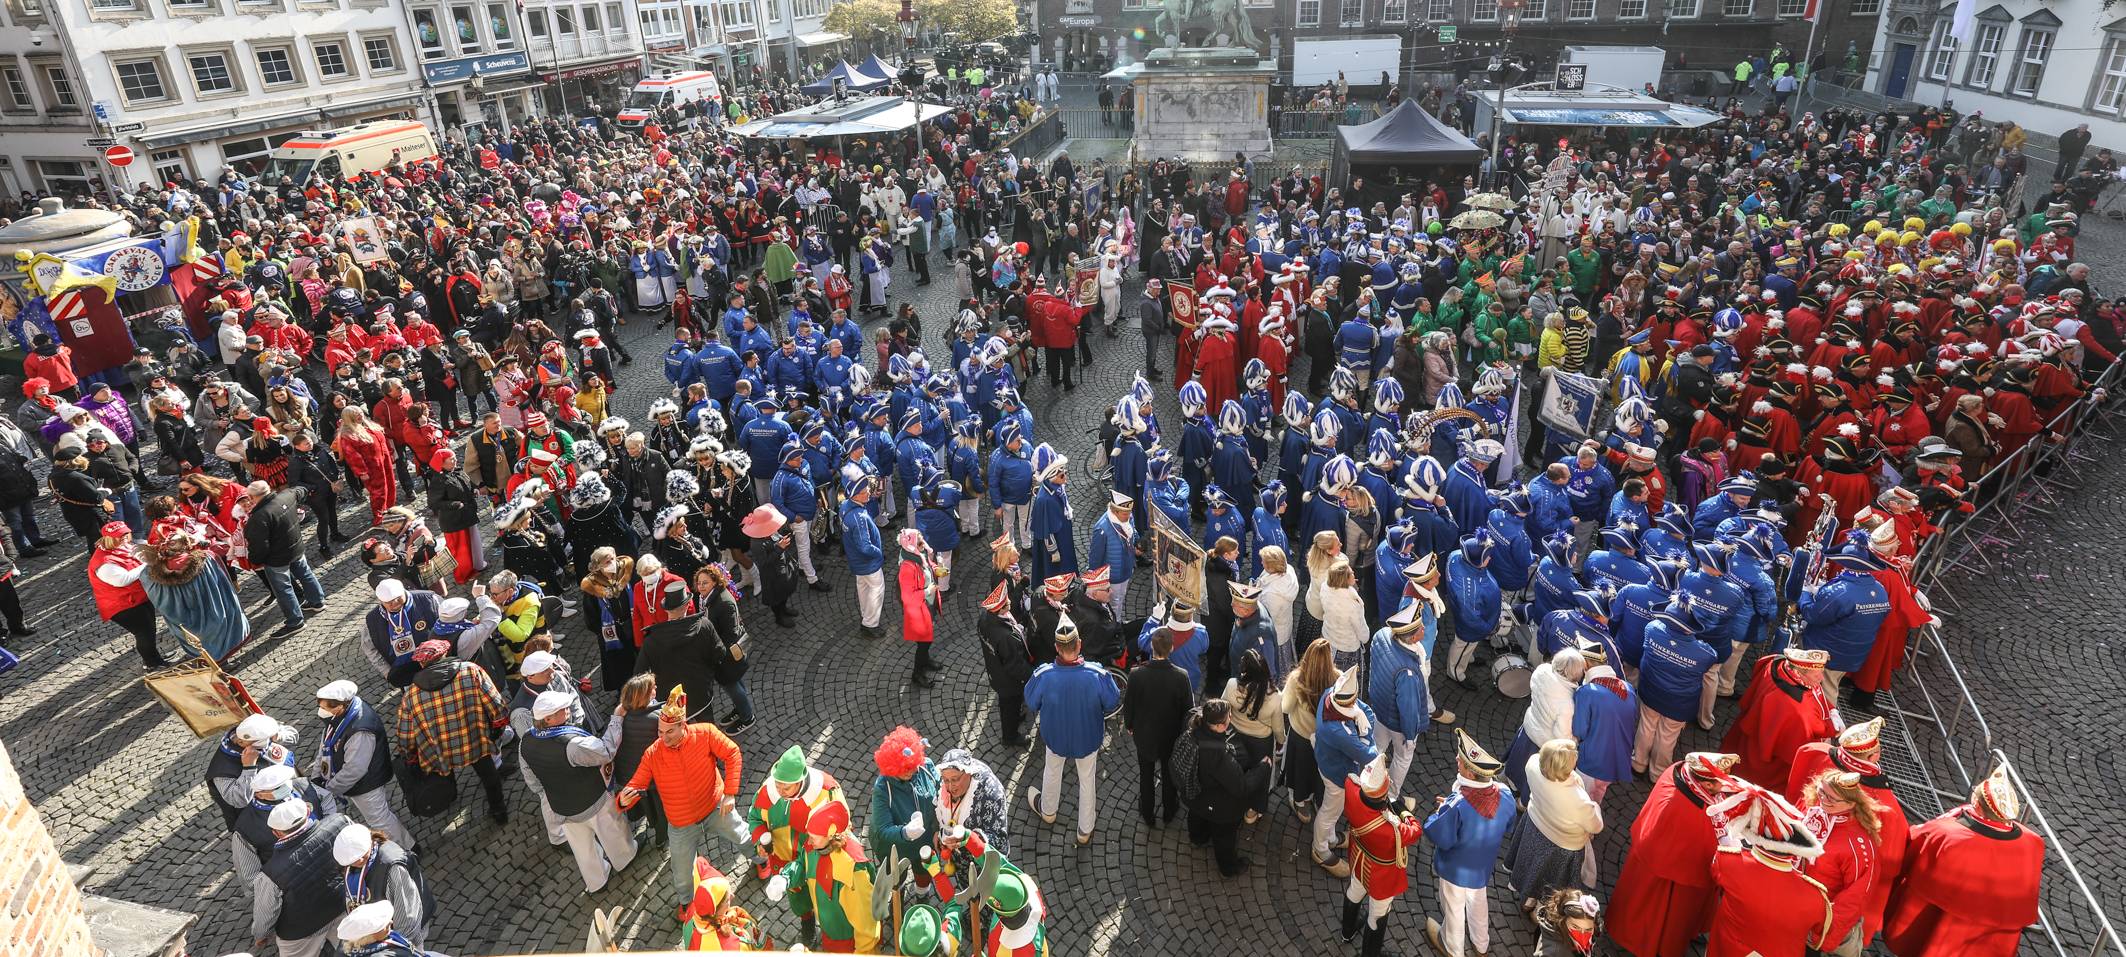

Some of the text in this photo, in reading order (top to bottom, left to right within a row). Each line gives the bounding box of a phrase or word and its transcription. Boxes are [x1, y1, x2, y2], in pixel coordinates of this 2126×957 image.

[401, 143, 426, 153] Malteser
[105, 247, 160, 273] CARNEVAL IN
[115, 264, 162, 290] SSELDORF
[1649, 638, 1697, 666] PRINZENGARDE
